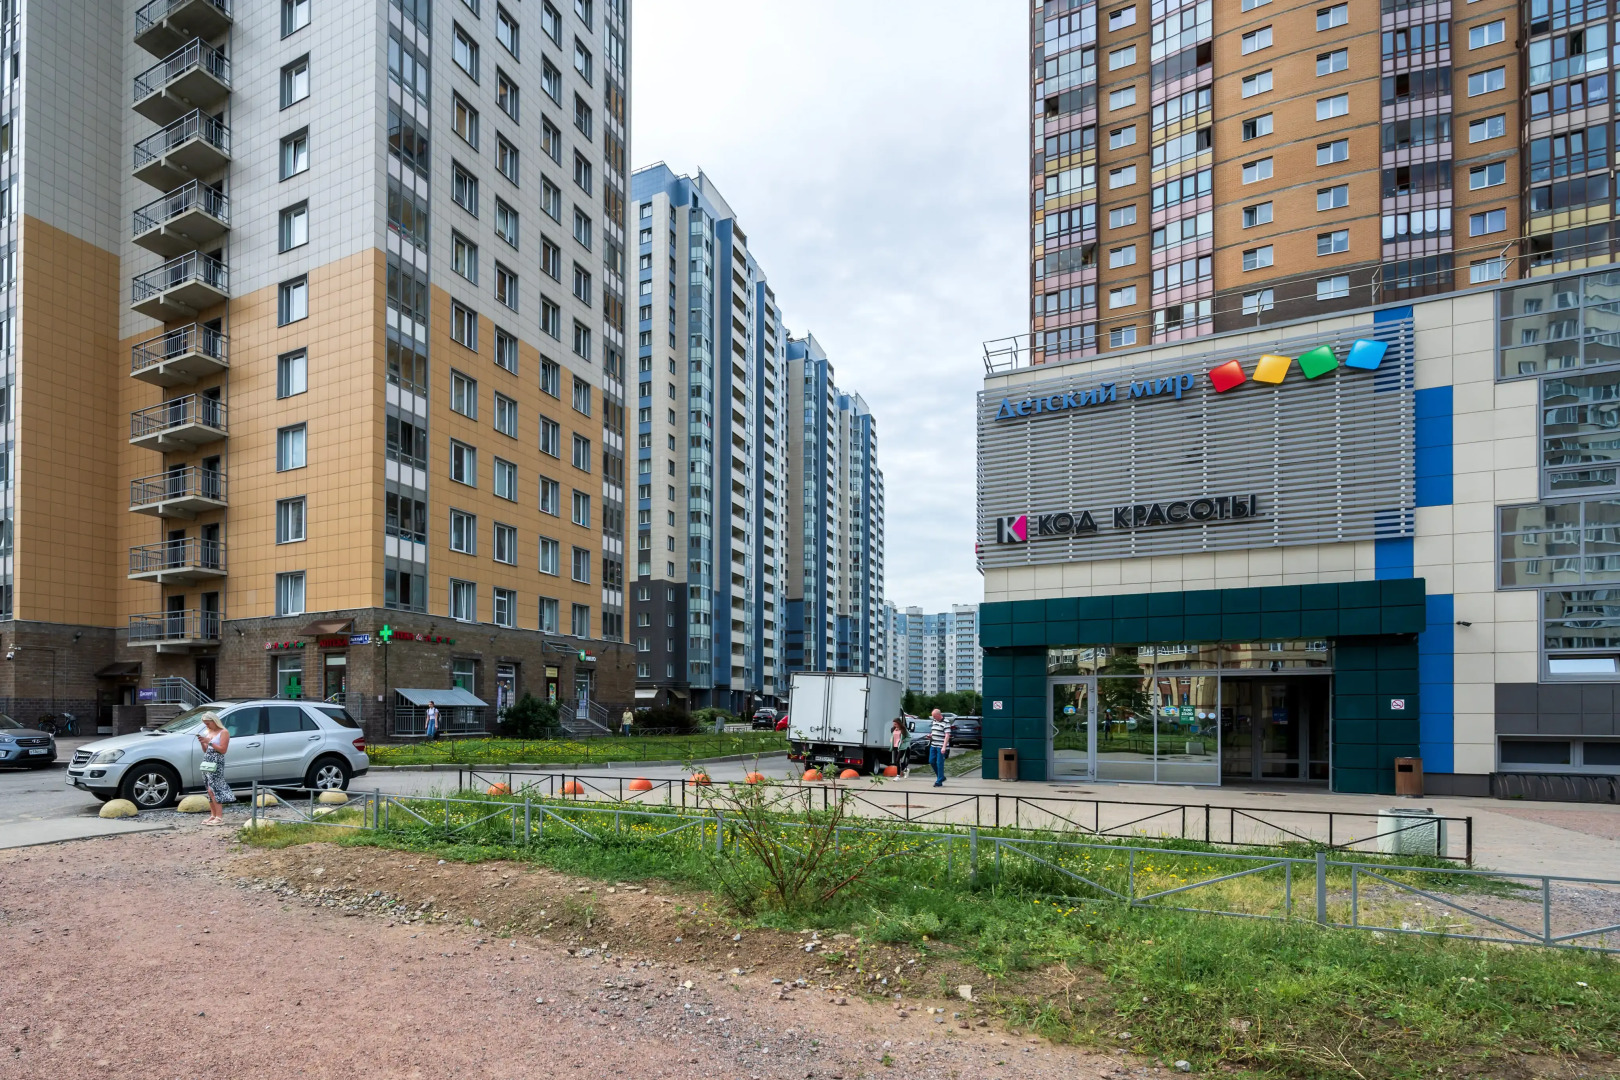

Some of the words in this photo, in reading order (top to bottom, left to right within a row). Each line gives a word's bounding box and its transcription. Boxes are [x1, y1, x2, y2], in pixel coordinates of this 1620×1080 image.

[995, 382, 1117, 421] Детский
[1127, 373, 1195, 399] мир
[1038, 510, 1098, 535] КОД
[1112, 494, 1256, 528] КРАСОТЫ
